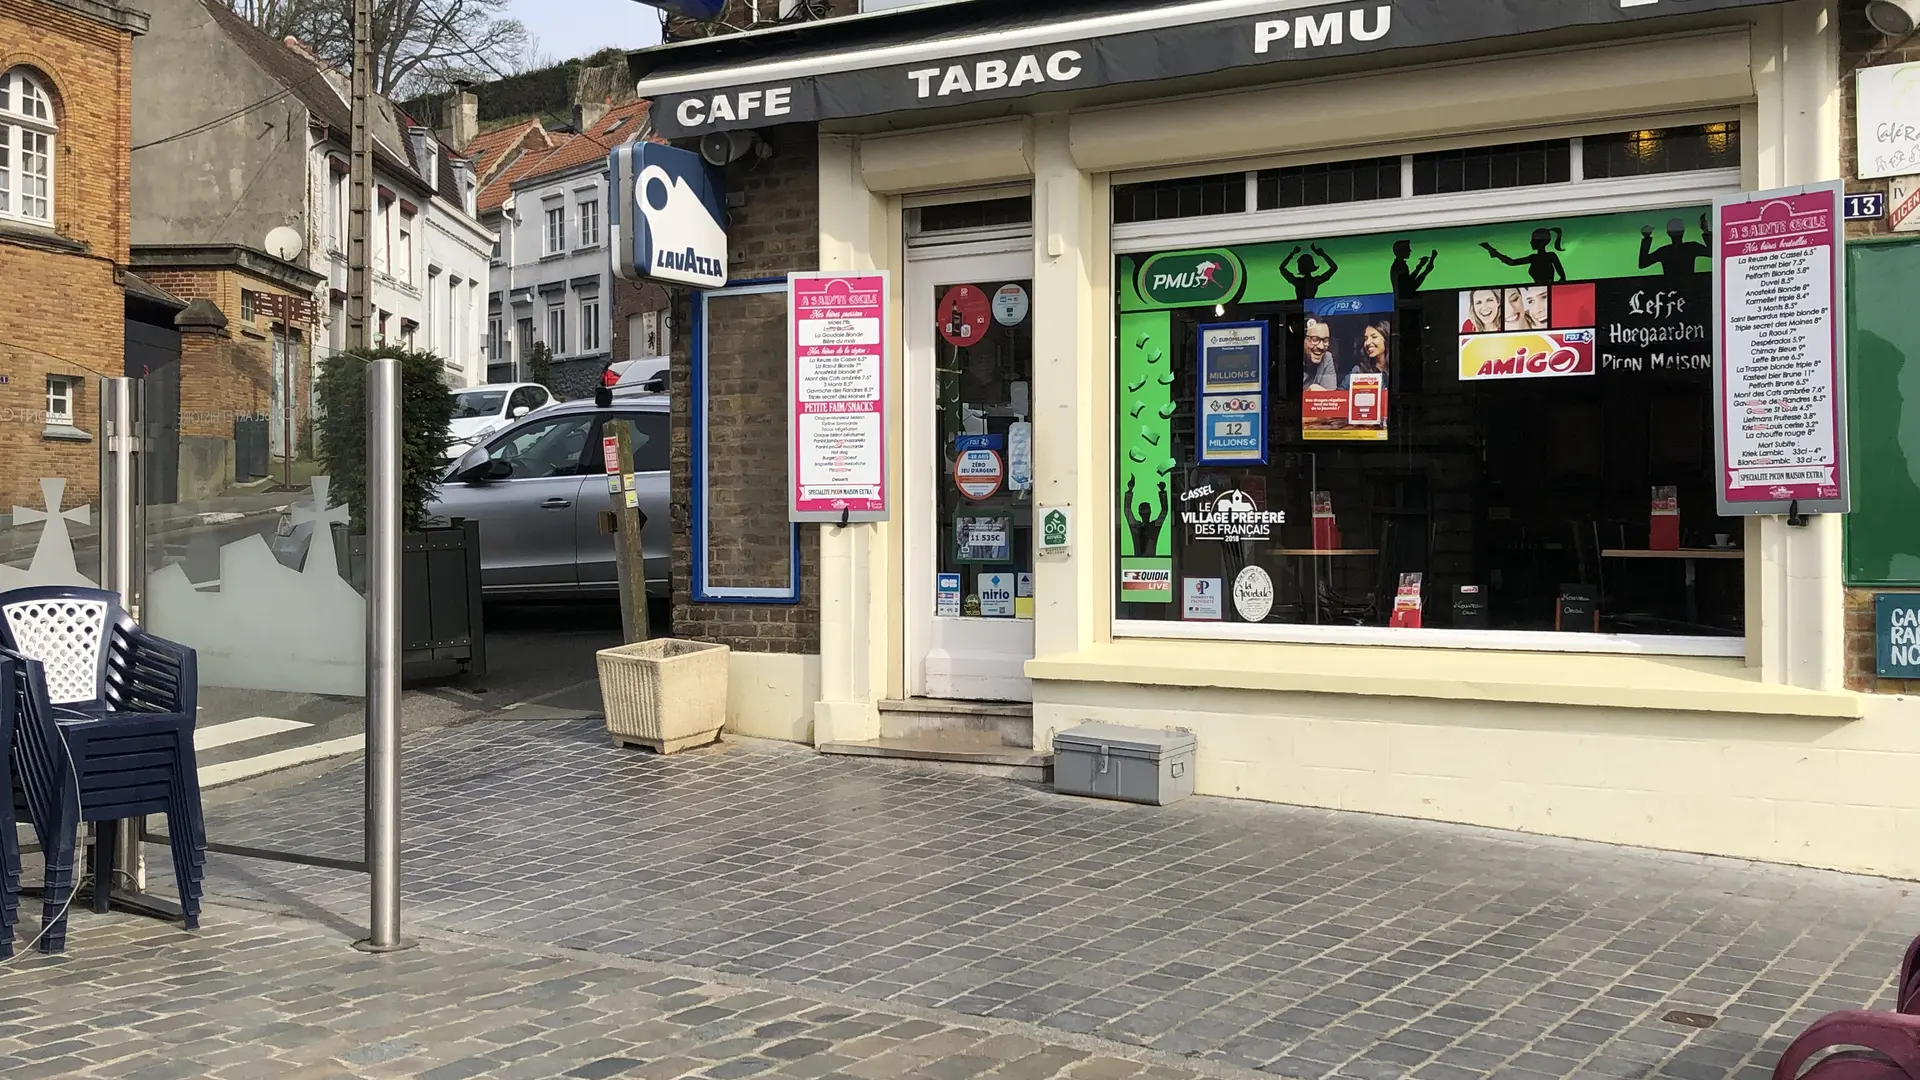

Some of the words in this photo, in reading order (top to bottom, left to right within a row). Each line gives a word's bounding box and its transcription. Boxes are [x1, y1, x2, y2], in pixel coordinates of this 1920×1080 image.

[1254, 5, 1391, 54] PMU
[907, 50, 1082, 98] TABAC
[676, 87, 792, 127] CAFE
[1876, 122, 1904, 144] Café
[1893, 187, 1907, 199] IV
[1850, 197, 1875, 216] 13
[1729, 228, 1738, 239] A
[1742, 221, 1786, 237] SAINTE
[1742, 242, 1758, 254] Nos
[1780, 250, 1802, 259] Cassel
[656, 247, 723, 277] LAVAZZA
[1749, 262, 1777, 271] Hommel
[1746, 272, 1770, 280] Pelforth
[1772, 269, 1794, 277] Blonde
[1153, 272, 1195, 290] PMU
[1761, 278, 1779, 286] Duvel
[1778, 285, 1801, 293] Blonde
[1763, 304, 1783, 312] Monts
[1780, 311, 1795, 319] triple
[1789, 318, 1812, 326] Moines
[1566, 333, 1580, 341] FDJ
[1609, 322, 1704, 348] Hoegaarden
[1746, 364, 1768, 373] Trappe
[1770, 362, 1794, 370] blonde
[1210, 371, 1249, 379] MILLIONS
[1769, 371, 1781, 379] bier
[1783, 387, 1810, 395] ambrée
[804, 402, 828, 412] PETITE
[1226, 423, 1242, 435] 12
[1784, 421, 1804, 429] cerise
[1209, 439, 1249, 447] MILLIONS
[1740, 473, 1768, 481] SPECIALITE
[1769, 472, 1784, 480] PICON
[1806, 471, 1823, 479] EXTRA
[1180, 484, 1215, 501] CASSEL
[1199, 502, 1211, 512] LE
[1181, 512, 1229, 523] VILLAGE
[1231, 510, 1285, 523] PRÉFÉRÉ
[1195, 524, 1215, 535] DES
[1217, 524, 1270, 537] FRANÇAIS
[982, 589, 1010, 600] nirio
[1891, 608, 1920, 627] CA
[1891, 626, 1920, 644] RA
